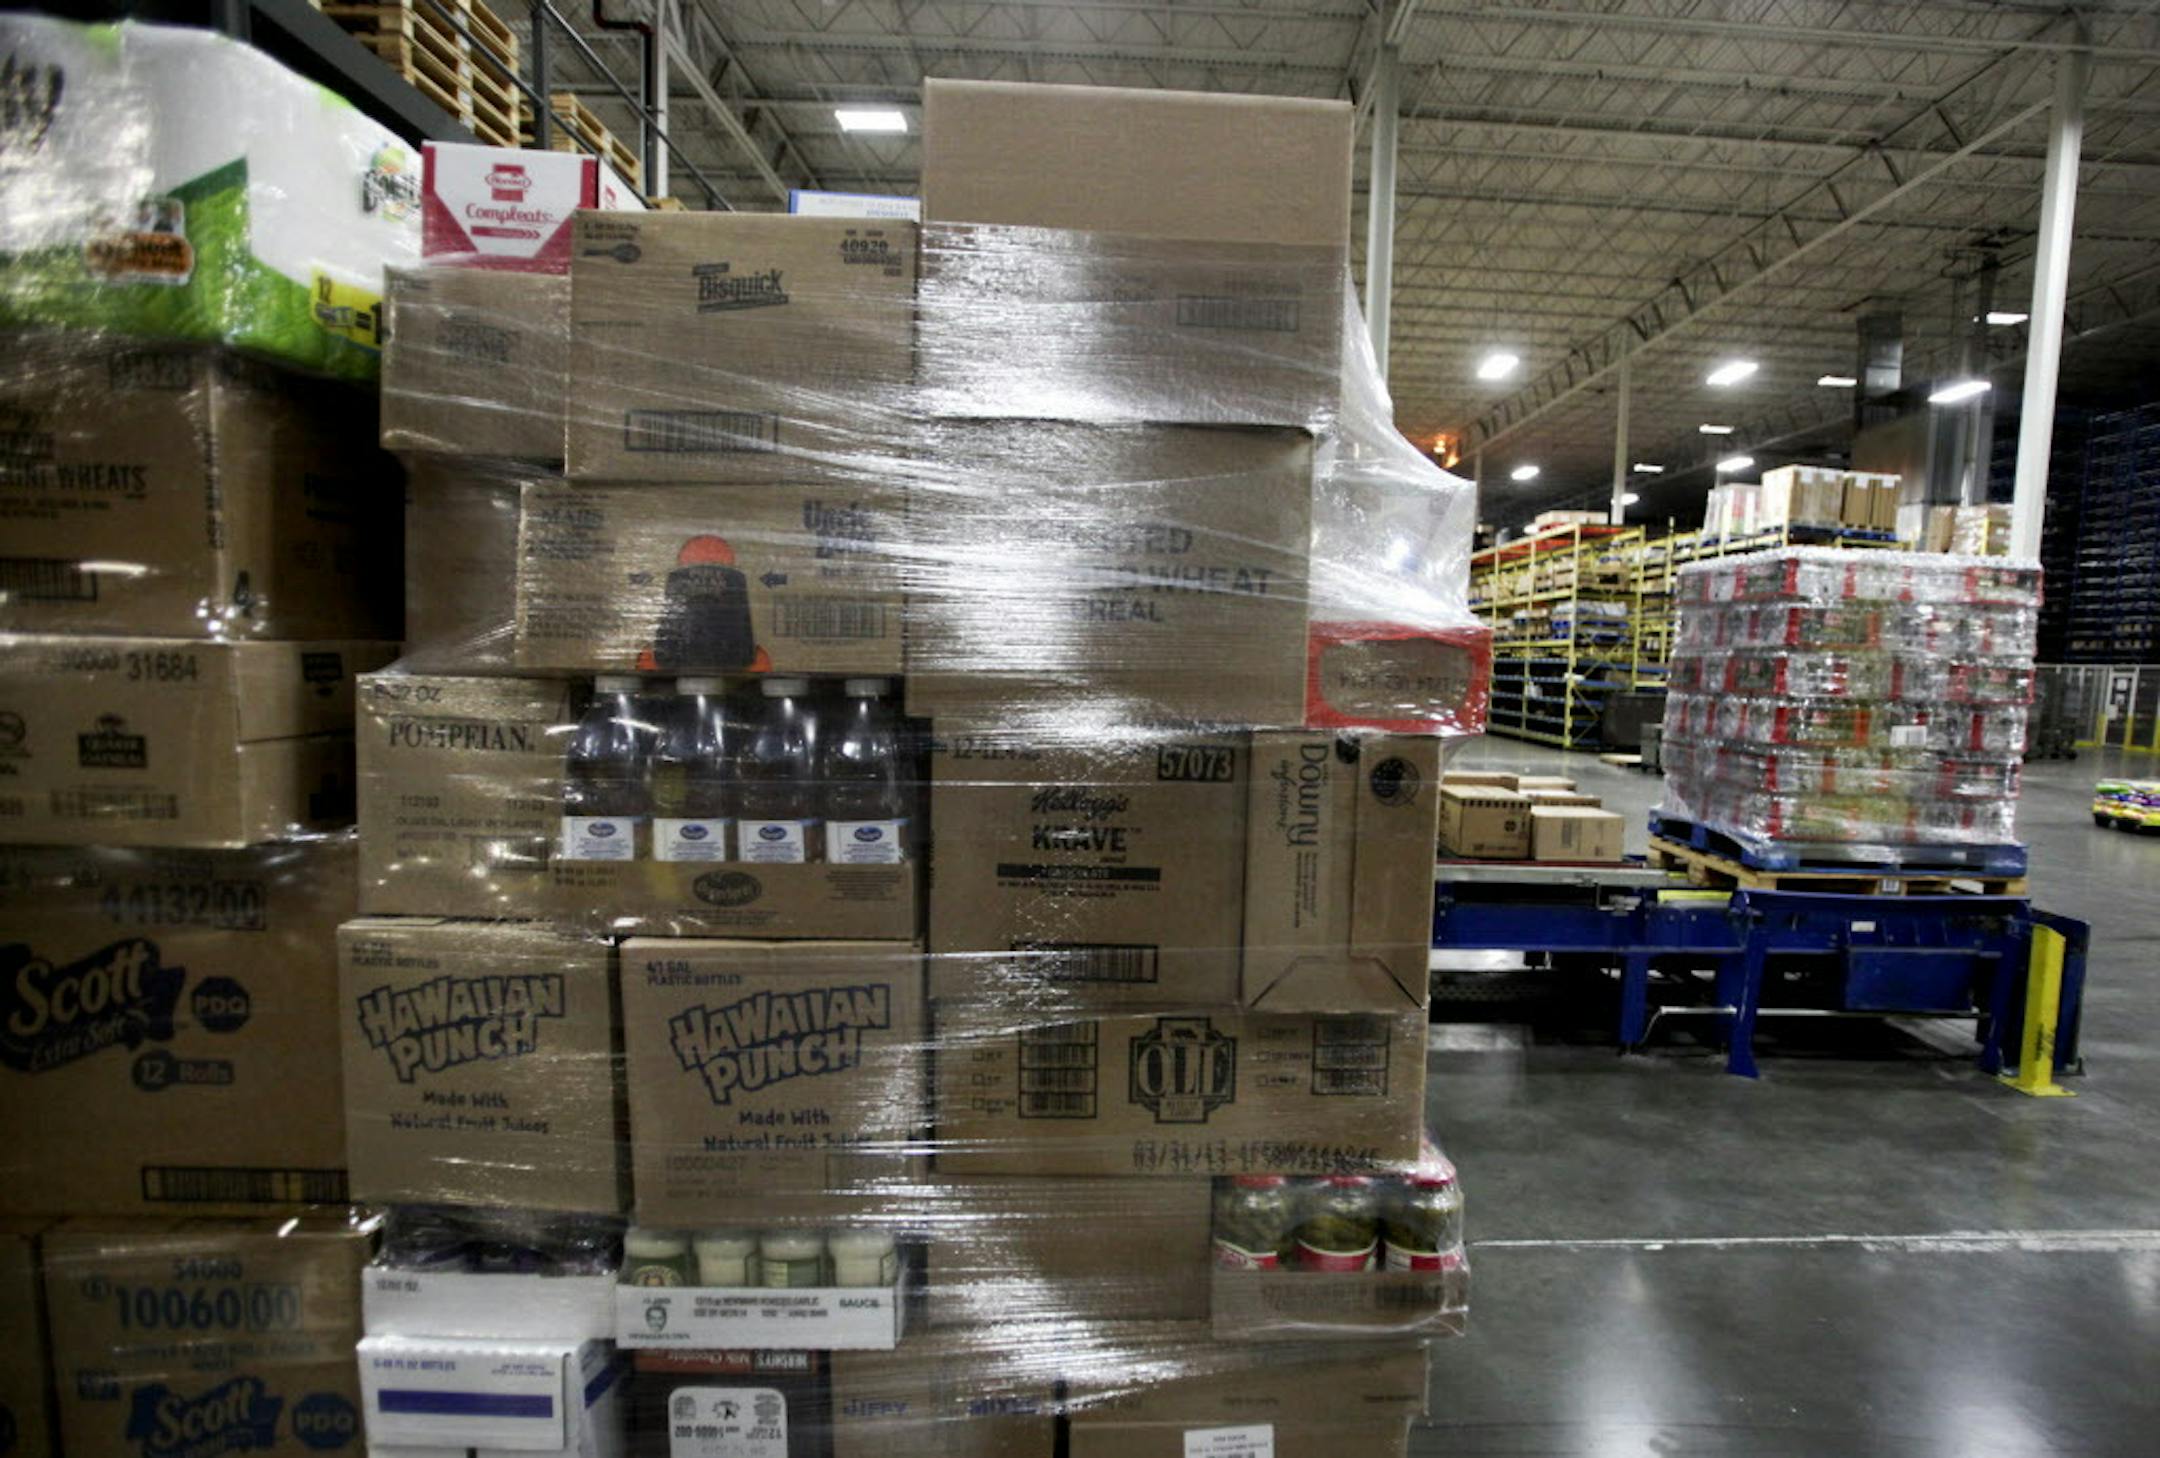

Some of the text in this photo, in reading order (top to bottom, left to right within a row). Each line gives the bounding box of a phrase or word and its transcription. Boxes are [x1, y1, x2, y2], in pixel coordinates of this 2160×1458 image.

[699, 268, 784, 302] Bisquick
[56, 463, 148, 491] WHEATS
[1160, 747, 1232, 779] 57073
[1286, 743, 1329, 846] Downy
[1032, 825, 1128, 852] KRAVE
[8, 941, 150, 1036] Scott
[358, 973, 565, 1049] HAWAIIAN
[668, 984, 890, 1071] HAWAIIAN
[386, 1014, 538, 1083] PUNCH
[142, 1062, 164, 1084] 12
[702, 1029, 861, 1104] PUNCH
[423, 1091, 464, 1107] Made
[391, 1114, 450, 1130] Natural
[740, 1110, 785, 1126] Made
[704, 1133, 769, 1151] Natural
[775, 1134, 816, 1149] Fruit
[113, 1287, 241, 1331] 10060
[152, 1385, 254, 1449] Scott
